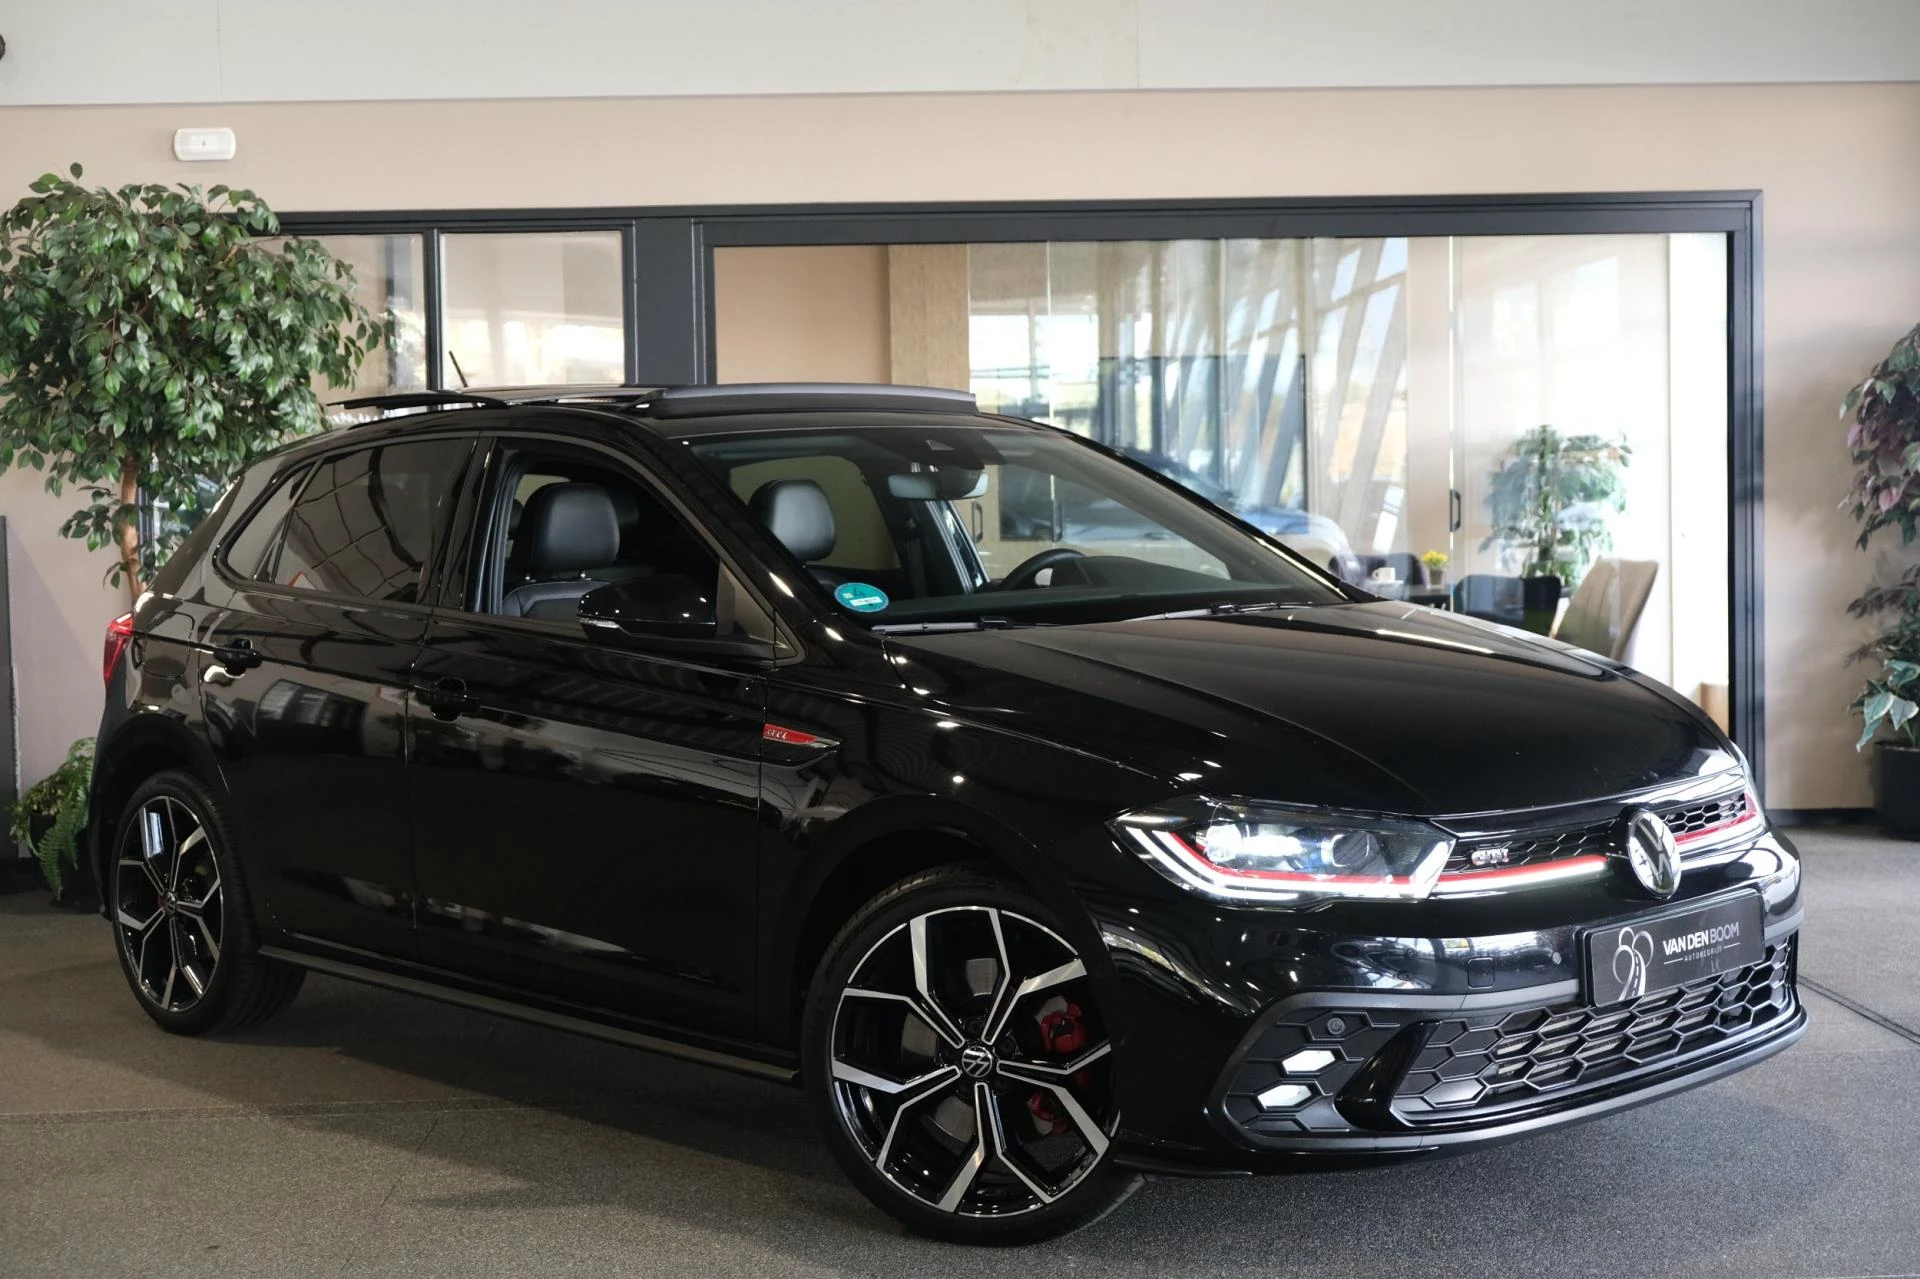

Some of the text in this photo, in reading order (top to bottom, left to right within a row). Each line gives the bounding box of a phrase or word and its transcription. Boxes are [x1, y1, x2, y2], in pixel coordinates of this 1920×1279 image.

[1662, 921, 1740, 956] VAN DEN BOOM
